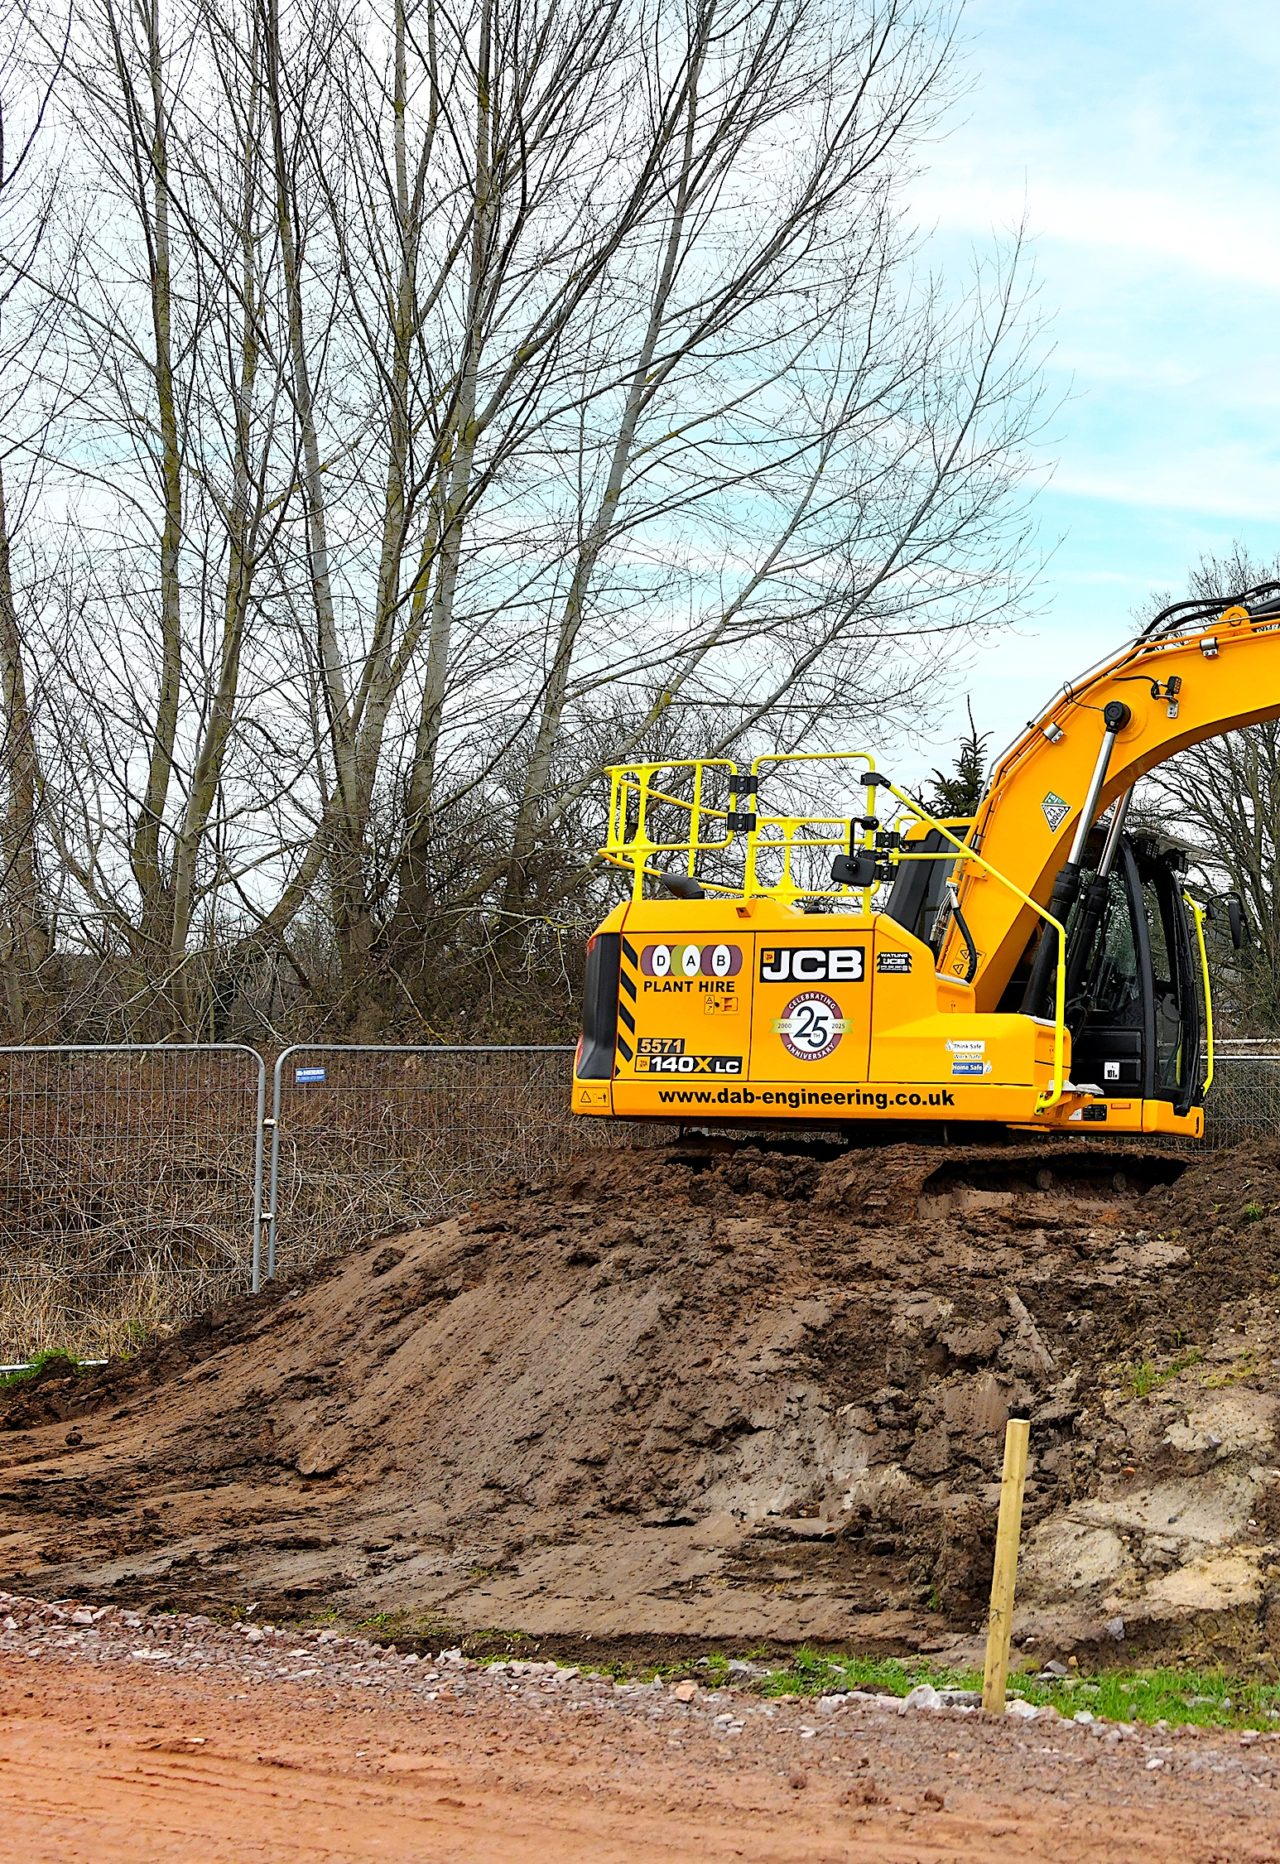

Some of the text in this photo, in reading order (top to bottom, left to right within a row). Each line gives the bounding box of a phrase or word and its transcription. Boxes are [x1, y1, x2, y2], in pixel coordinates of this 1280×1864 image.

[762, 949, 863, 981] JCB
[643, 981, 736, 993] PLANT HIRE
[788, 993, 836, 1010] CELEBRATING
[793, 1005, 829, 1048] 25
[640, 1039, 682, 1054] 5571
[786, 1043, 835, 1060] ANNIVERSARY
[658, 1088, 956, 1110] www.dab-engineering.co.uk
